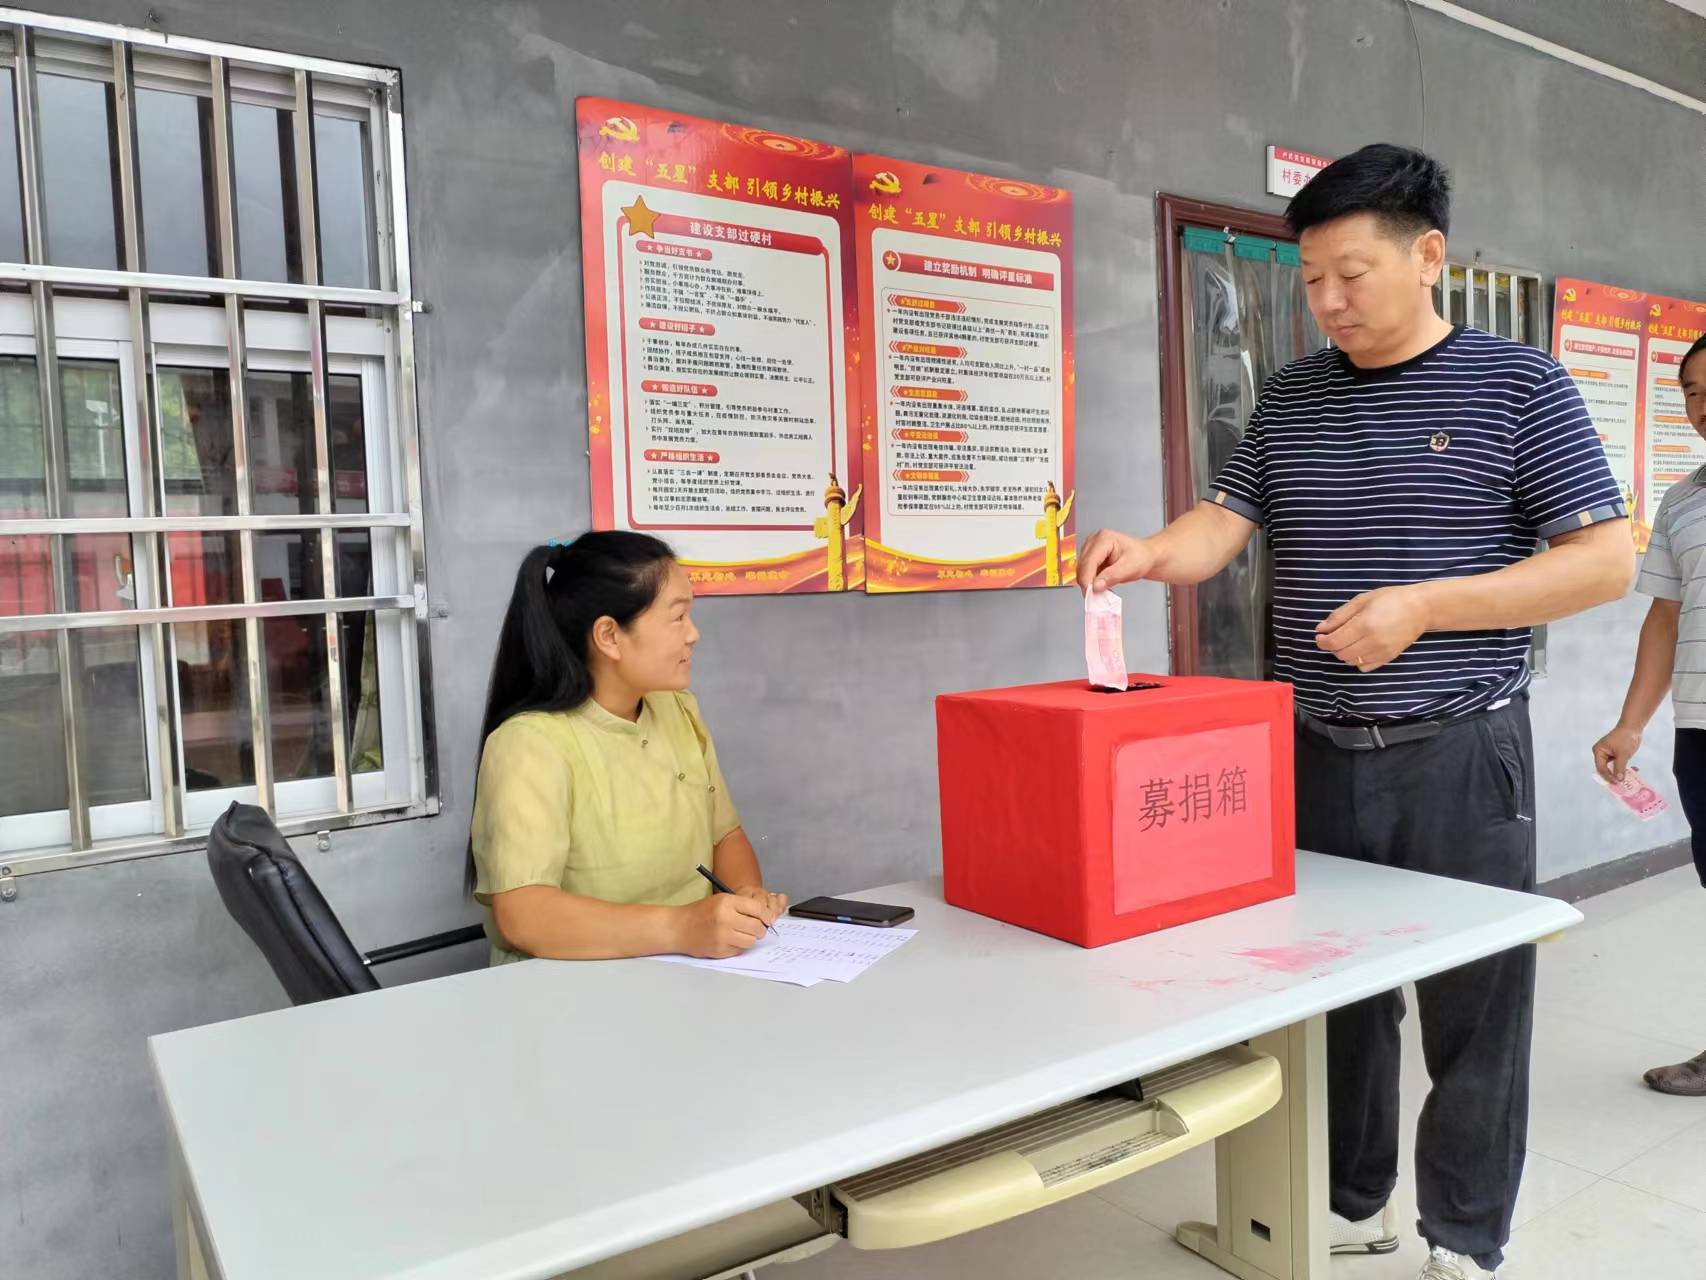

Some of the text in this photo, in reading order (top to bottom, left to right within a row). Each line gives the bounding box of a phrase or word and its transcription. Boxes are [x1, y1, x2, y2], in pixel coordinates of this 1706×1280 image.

[599, 151, 636, 177] 创建
[707, 170, 739, 194] 支部
[746, 177, 841, 209] 引领乡村振兴
[690, 222, 772, 246] 建设支部过硬村
[869, 203, 899, 224] 创建
[953, 216, 980, 237] 支部
[985, 221, 1062, 247] 引领乡村振兴
[923, 259, 977, 278] 建立奖励机制
[1138, 766, 1248, 832] 募捐箱
